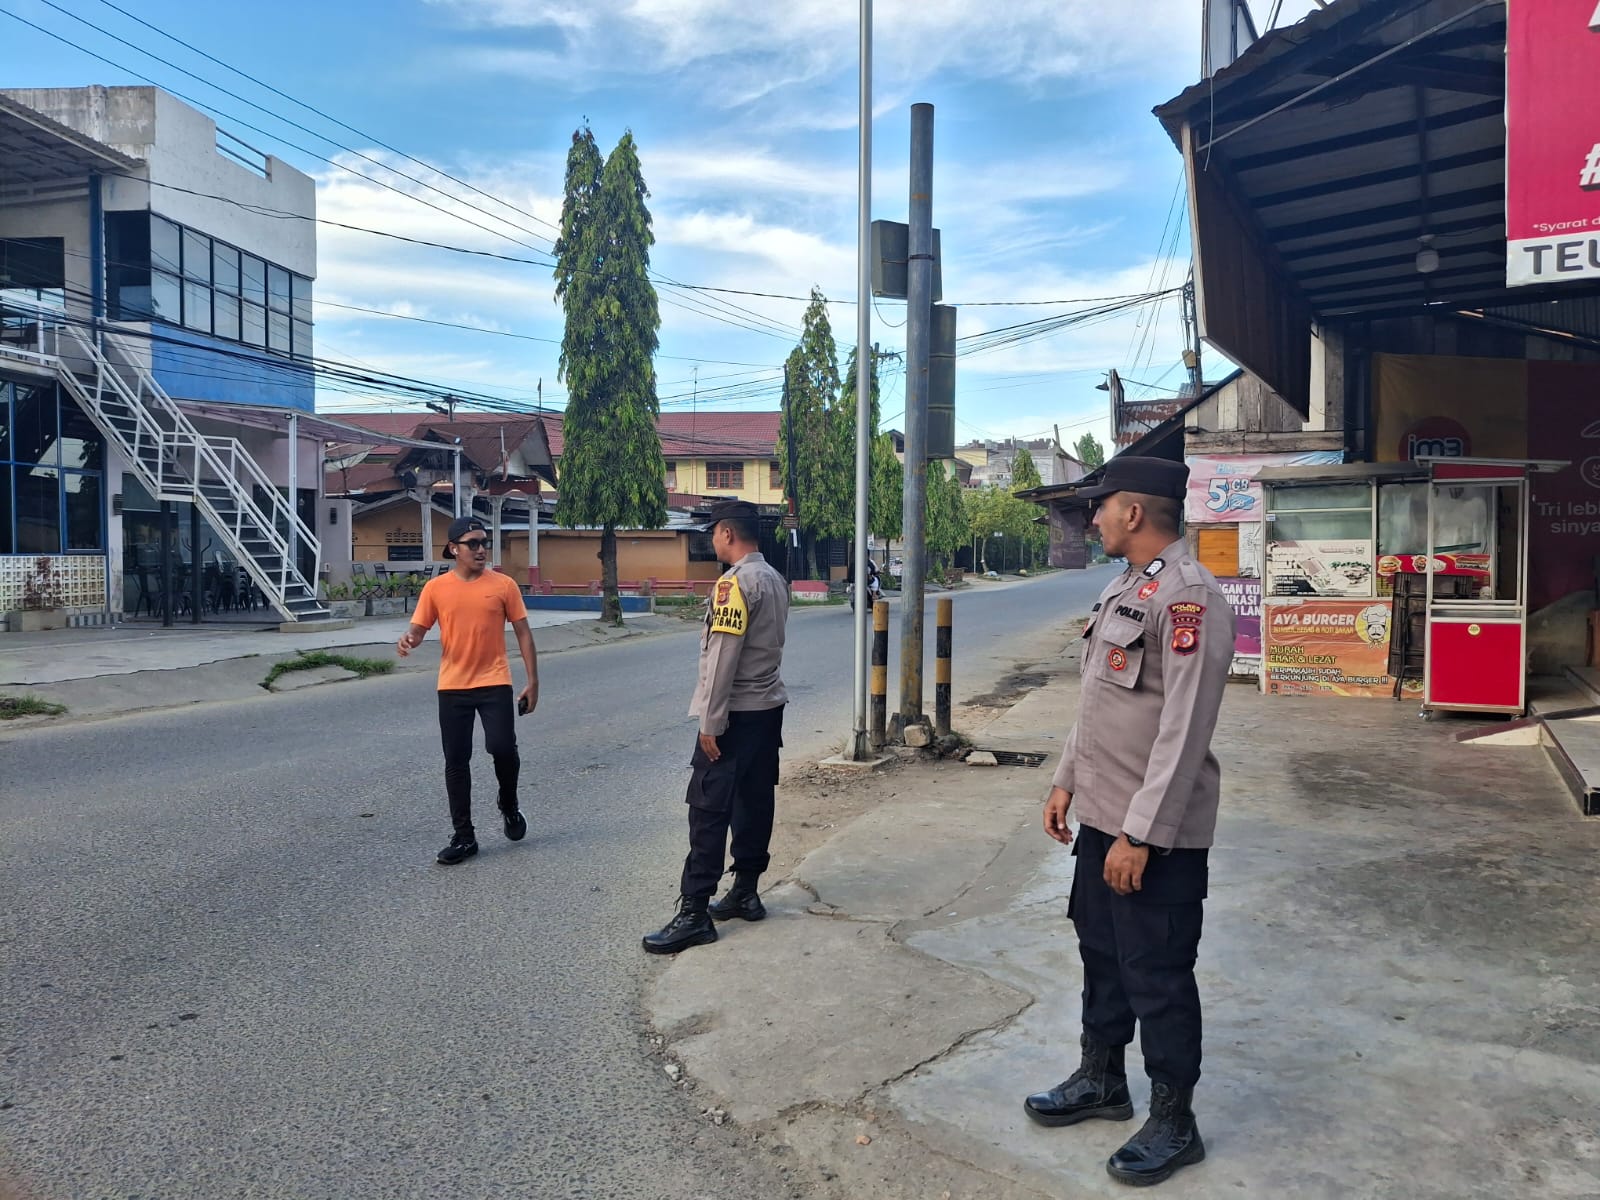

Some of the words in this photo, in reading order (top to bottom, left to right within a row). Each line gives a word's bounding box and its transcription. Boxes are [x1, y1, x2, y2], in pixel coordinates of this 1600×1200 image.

[1205, 478, 1229, 512] 5
[1537, 502, 1561, 516] Tri
[1567, 501, 1600, 516] leb
[1219, 583, 1243, 595] GAN
[1115, 605, 1145, 622] POLRI
[1274, 613, 1299, 625] AYA
[1302, 614, 1355, 626] BURGER
[712, 616, 743, 630] TIBMAS
[1269, 645, 1304, 655] MURAH
[1270, 654, 1295, 663] ENAK
[1297, 655, 1306, 663] &
[1308, 655, 1336, 664] LEZAT
